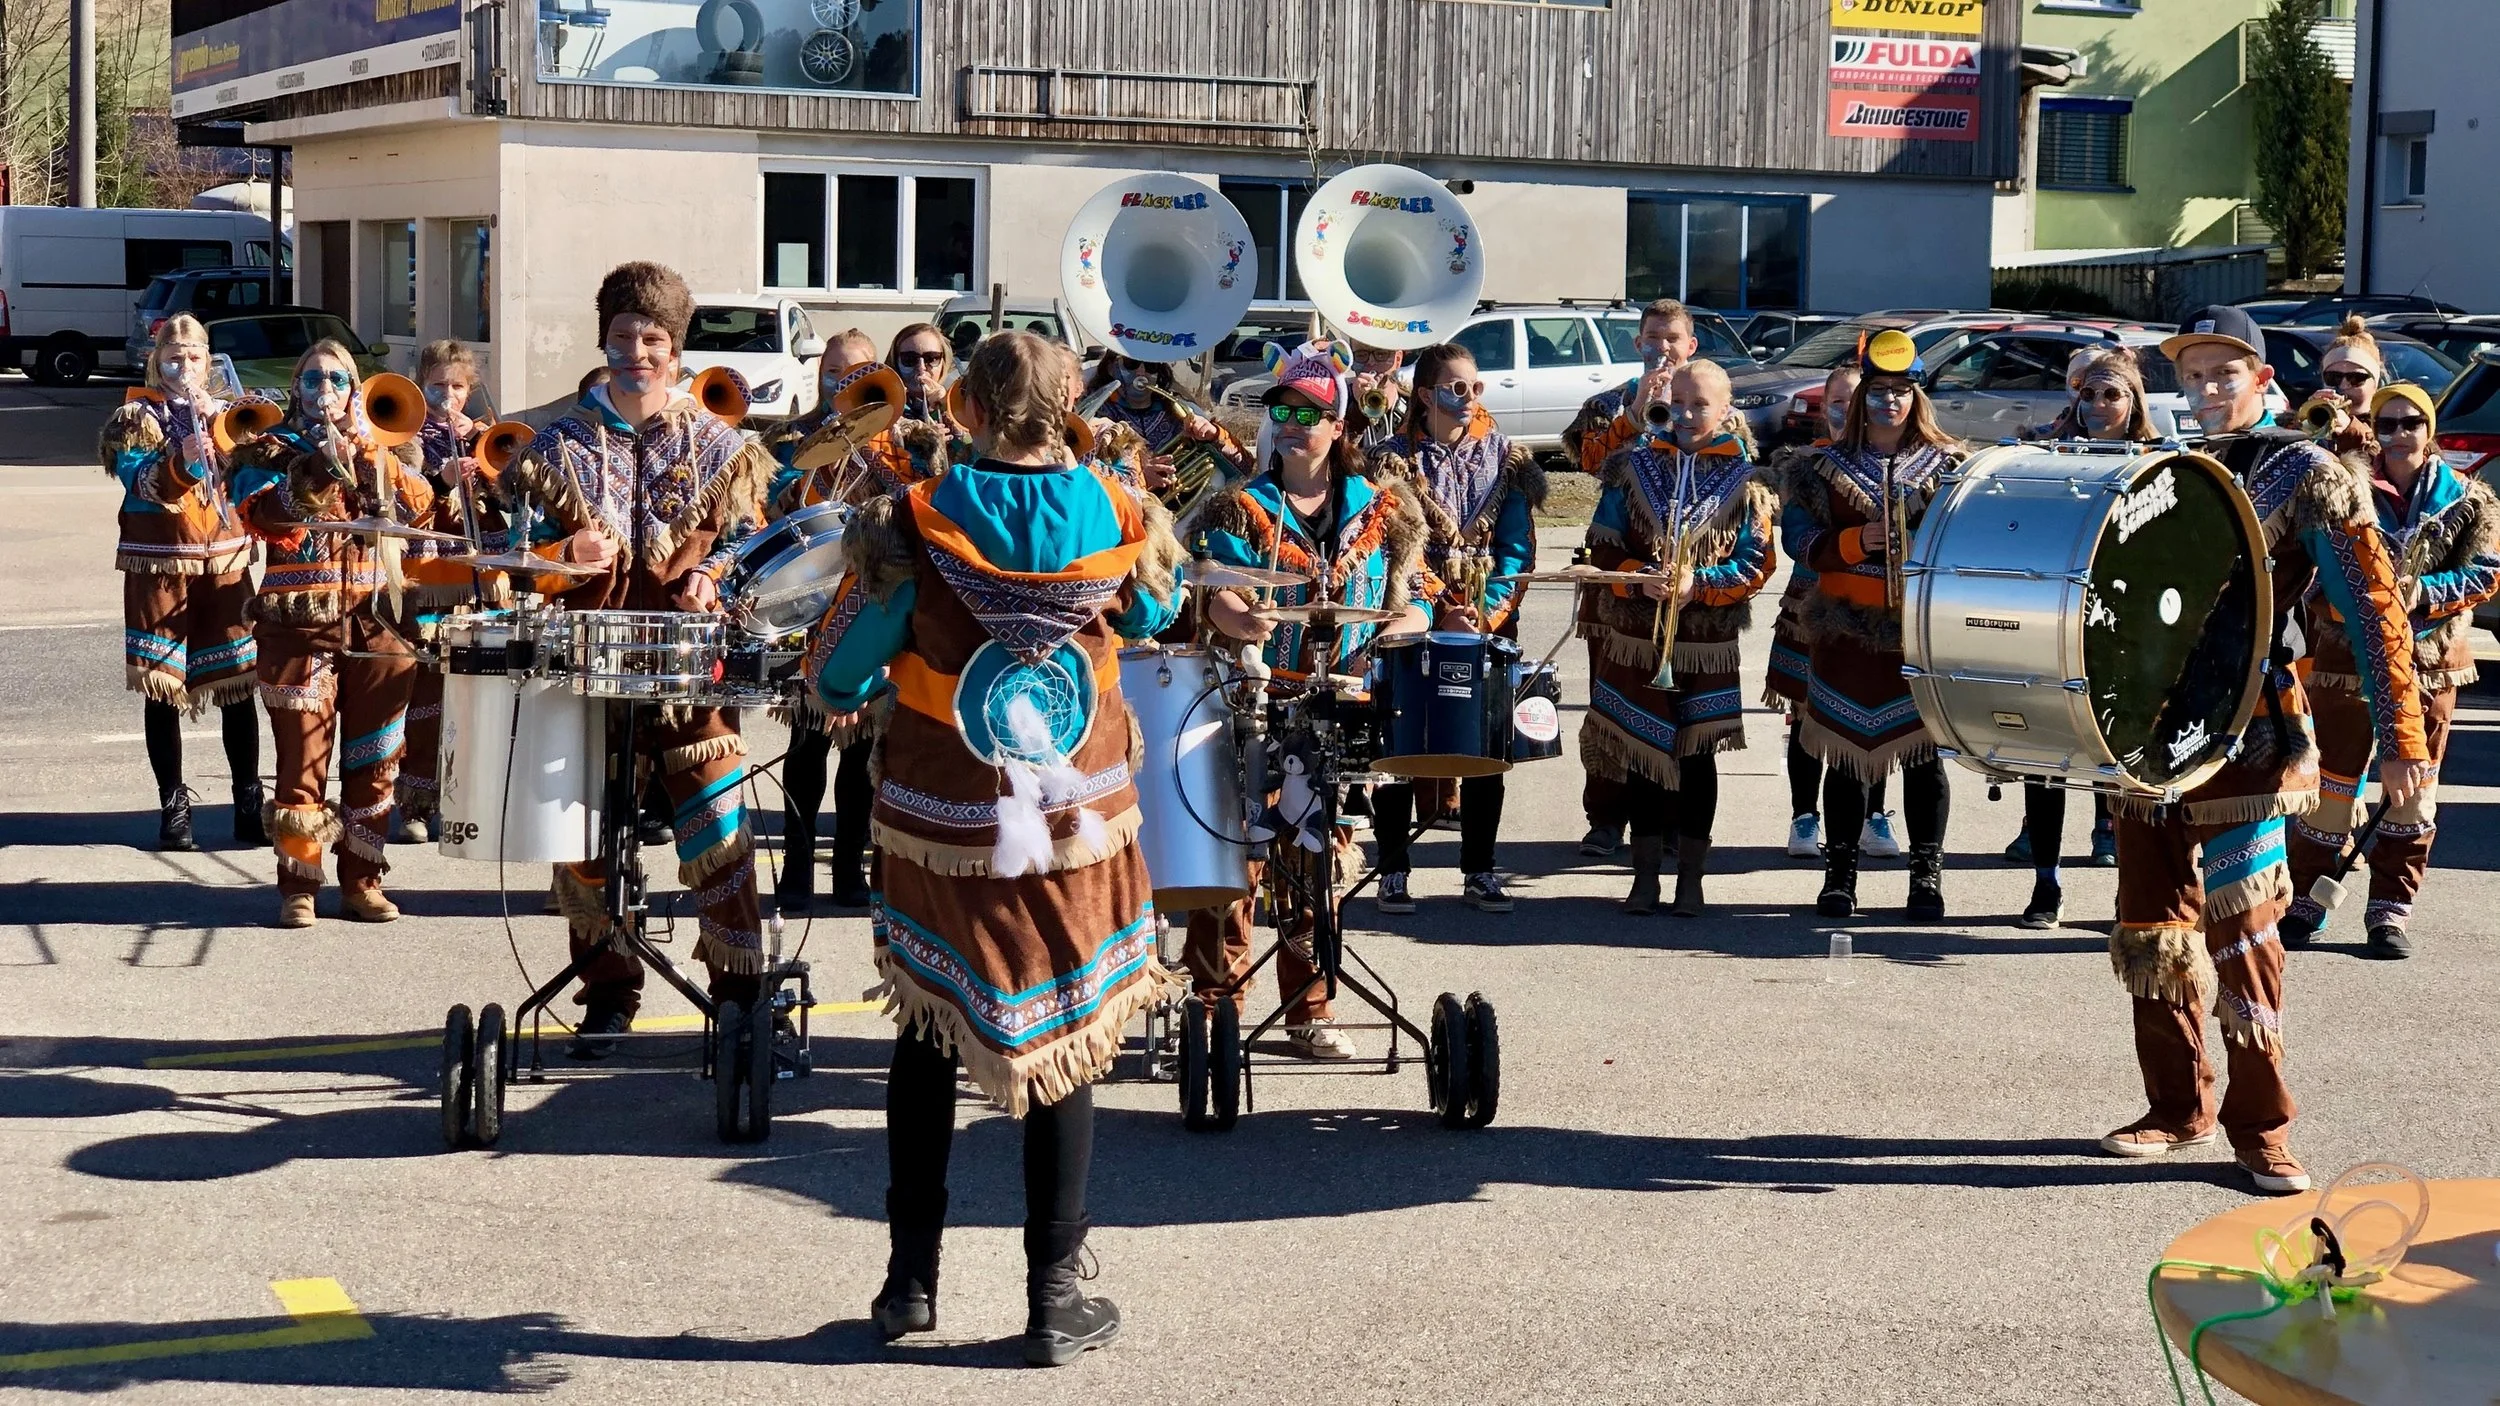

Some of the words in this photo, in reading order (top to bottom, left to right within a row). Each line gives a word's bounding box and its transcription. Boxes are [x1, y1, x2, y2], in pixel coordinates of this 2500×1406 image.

[1863, 0, 1974, 16] DUNLOP
[1864, 41, 1976, 69] FULDA
[1833, 70, 1885, 81] EUROPEAN
[1887, 73, 1913, 82] HIGH
[1916, 74, 1978, 85] TECHNOLOGY
[1845, 103, 1968, 128] BRIDGESTONE
[1120, 192, 1209, 210] FLÄCKLER
[1350, 190, 1436, 213] FLÄCKLER
